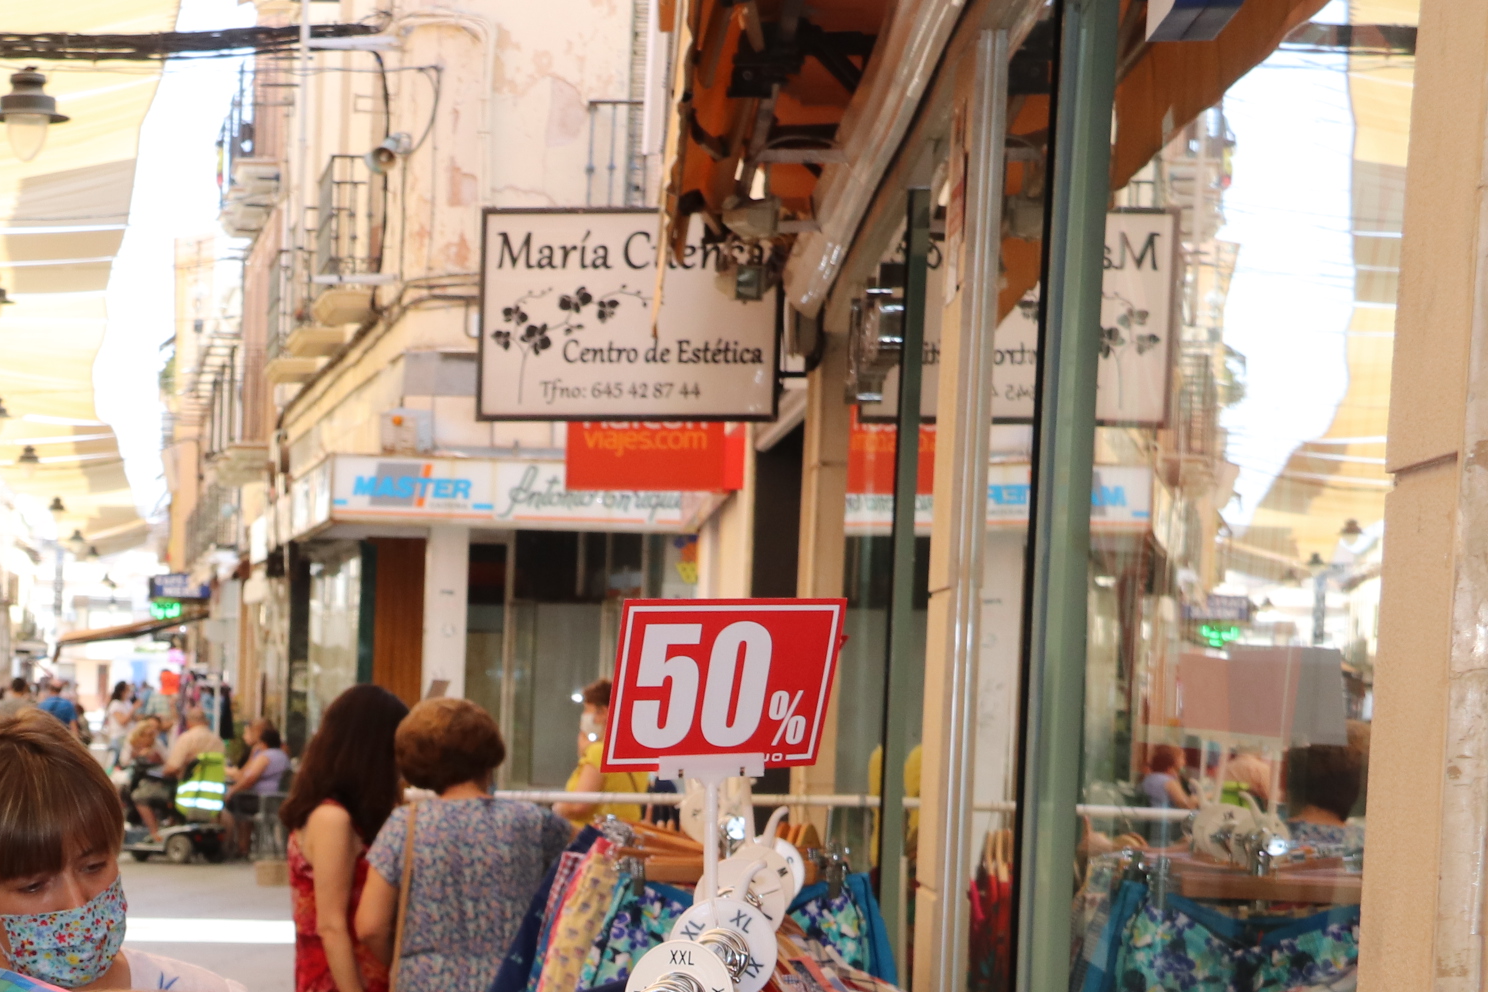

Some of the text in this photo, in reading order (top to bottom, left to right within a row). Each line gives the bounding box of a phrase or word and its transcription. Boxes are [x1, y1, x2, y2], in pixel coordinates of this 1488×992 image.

[496, 230, 611, 270] María
[563, 338, 764, 365] Centro de Estética
[540, 379, 700, 405] Tfno: 645 42 87 44
[584, 430, 707, 457] viajes.com
[353, 476, 472, 499] MASTER
[680, 920, 706, 941] XL
[729, 909, 752, 934] XL
[669, 949, 695, 966] XXL
